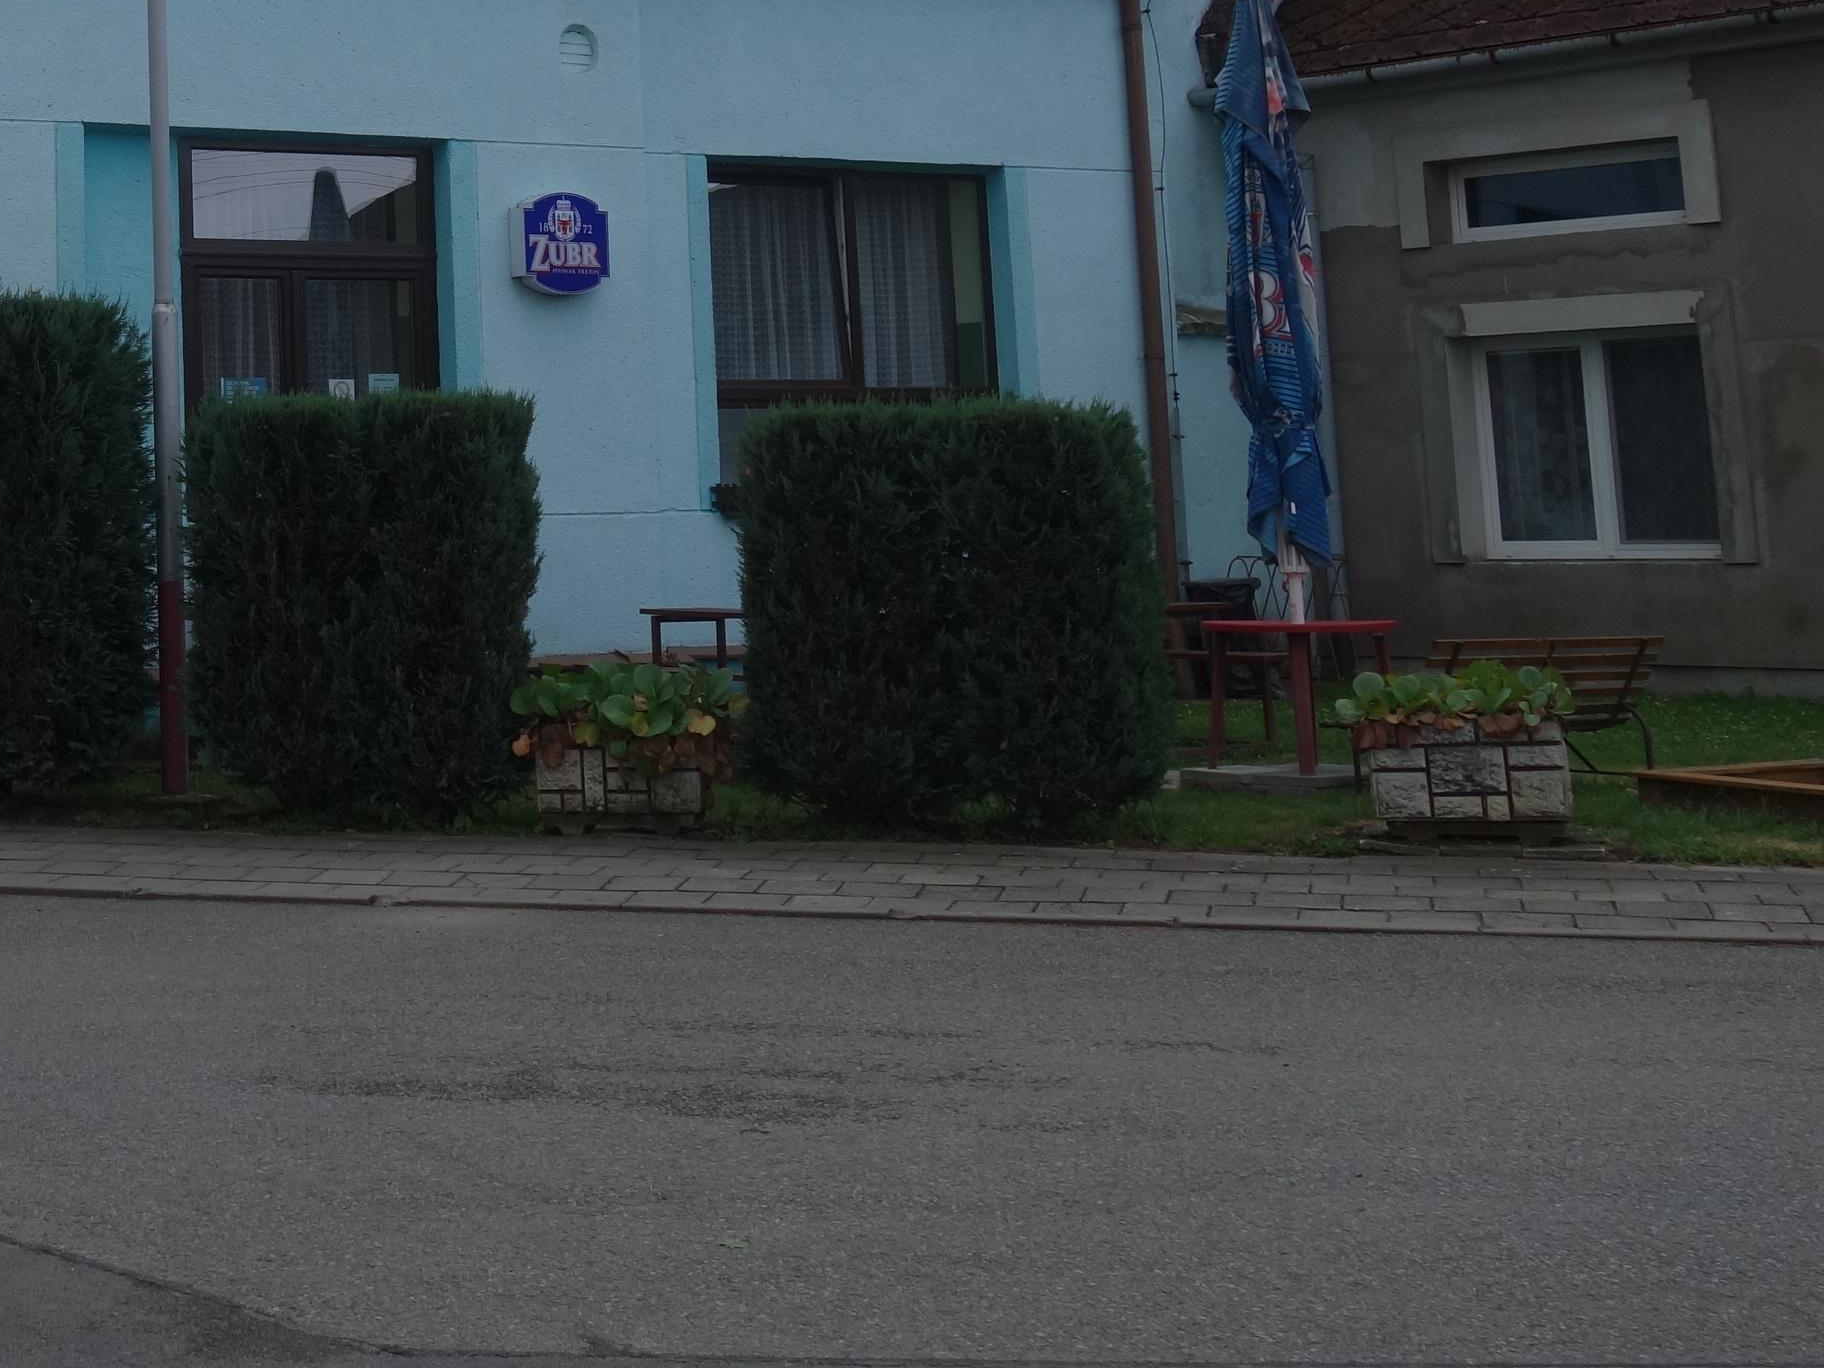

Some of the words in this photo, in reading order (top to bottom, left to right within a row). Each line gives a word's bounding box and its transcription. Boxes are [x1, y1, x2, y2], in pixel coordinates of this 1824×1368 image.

[539, 222, 549, 232] 18
[582, 225, 592, 234] 72
[528, 234, 601, 271] ZUBR
